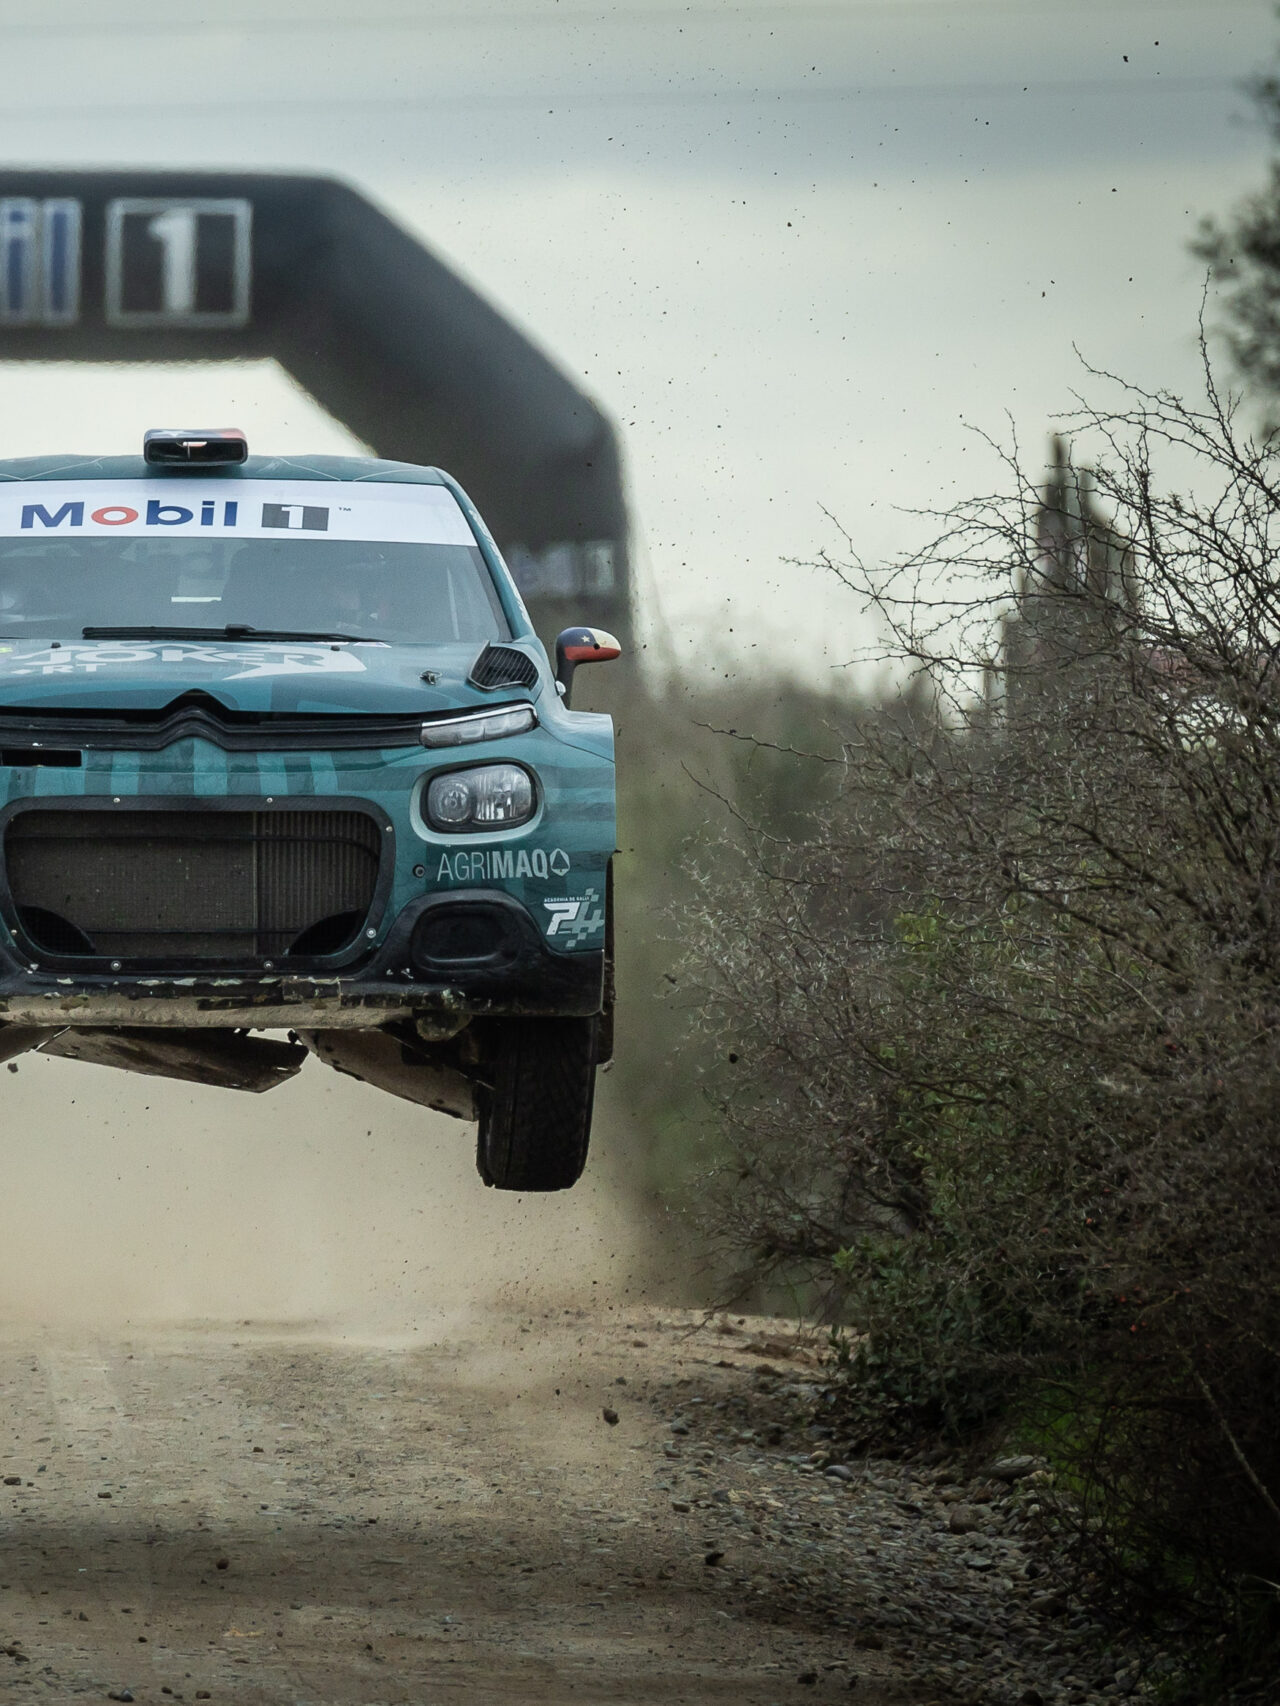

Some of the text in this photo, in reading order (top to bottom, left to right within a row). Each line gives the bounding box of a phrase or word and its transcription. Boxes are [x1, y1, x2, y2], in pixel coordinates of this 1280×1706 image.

[20, 500, 239, 529] Mobil
[24, 648, 326, 667] JOKER
[437, 848, 549, 882] AGRIMAQ
